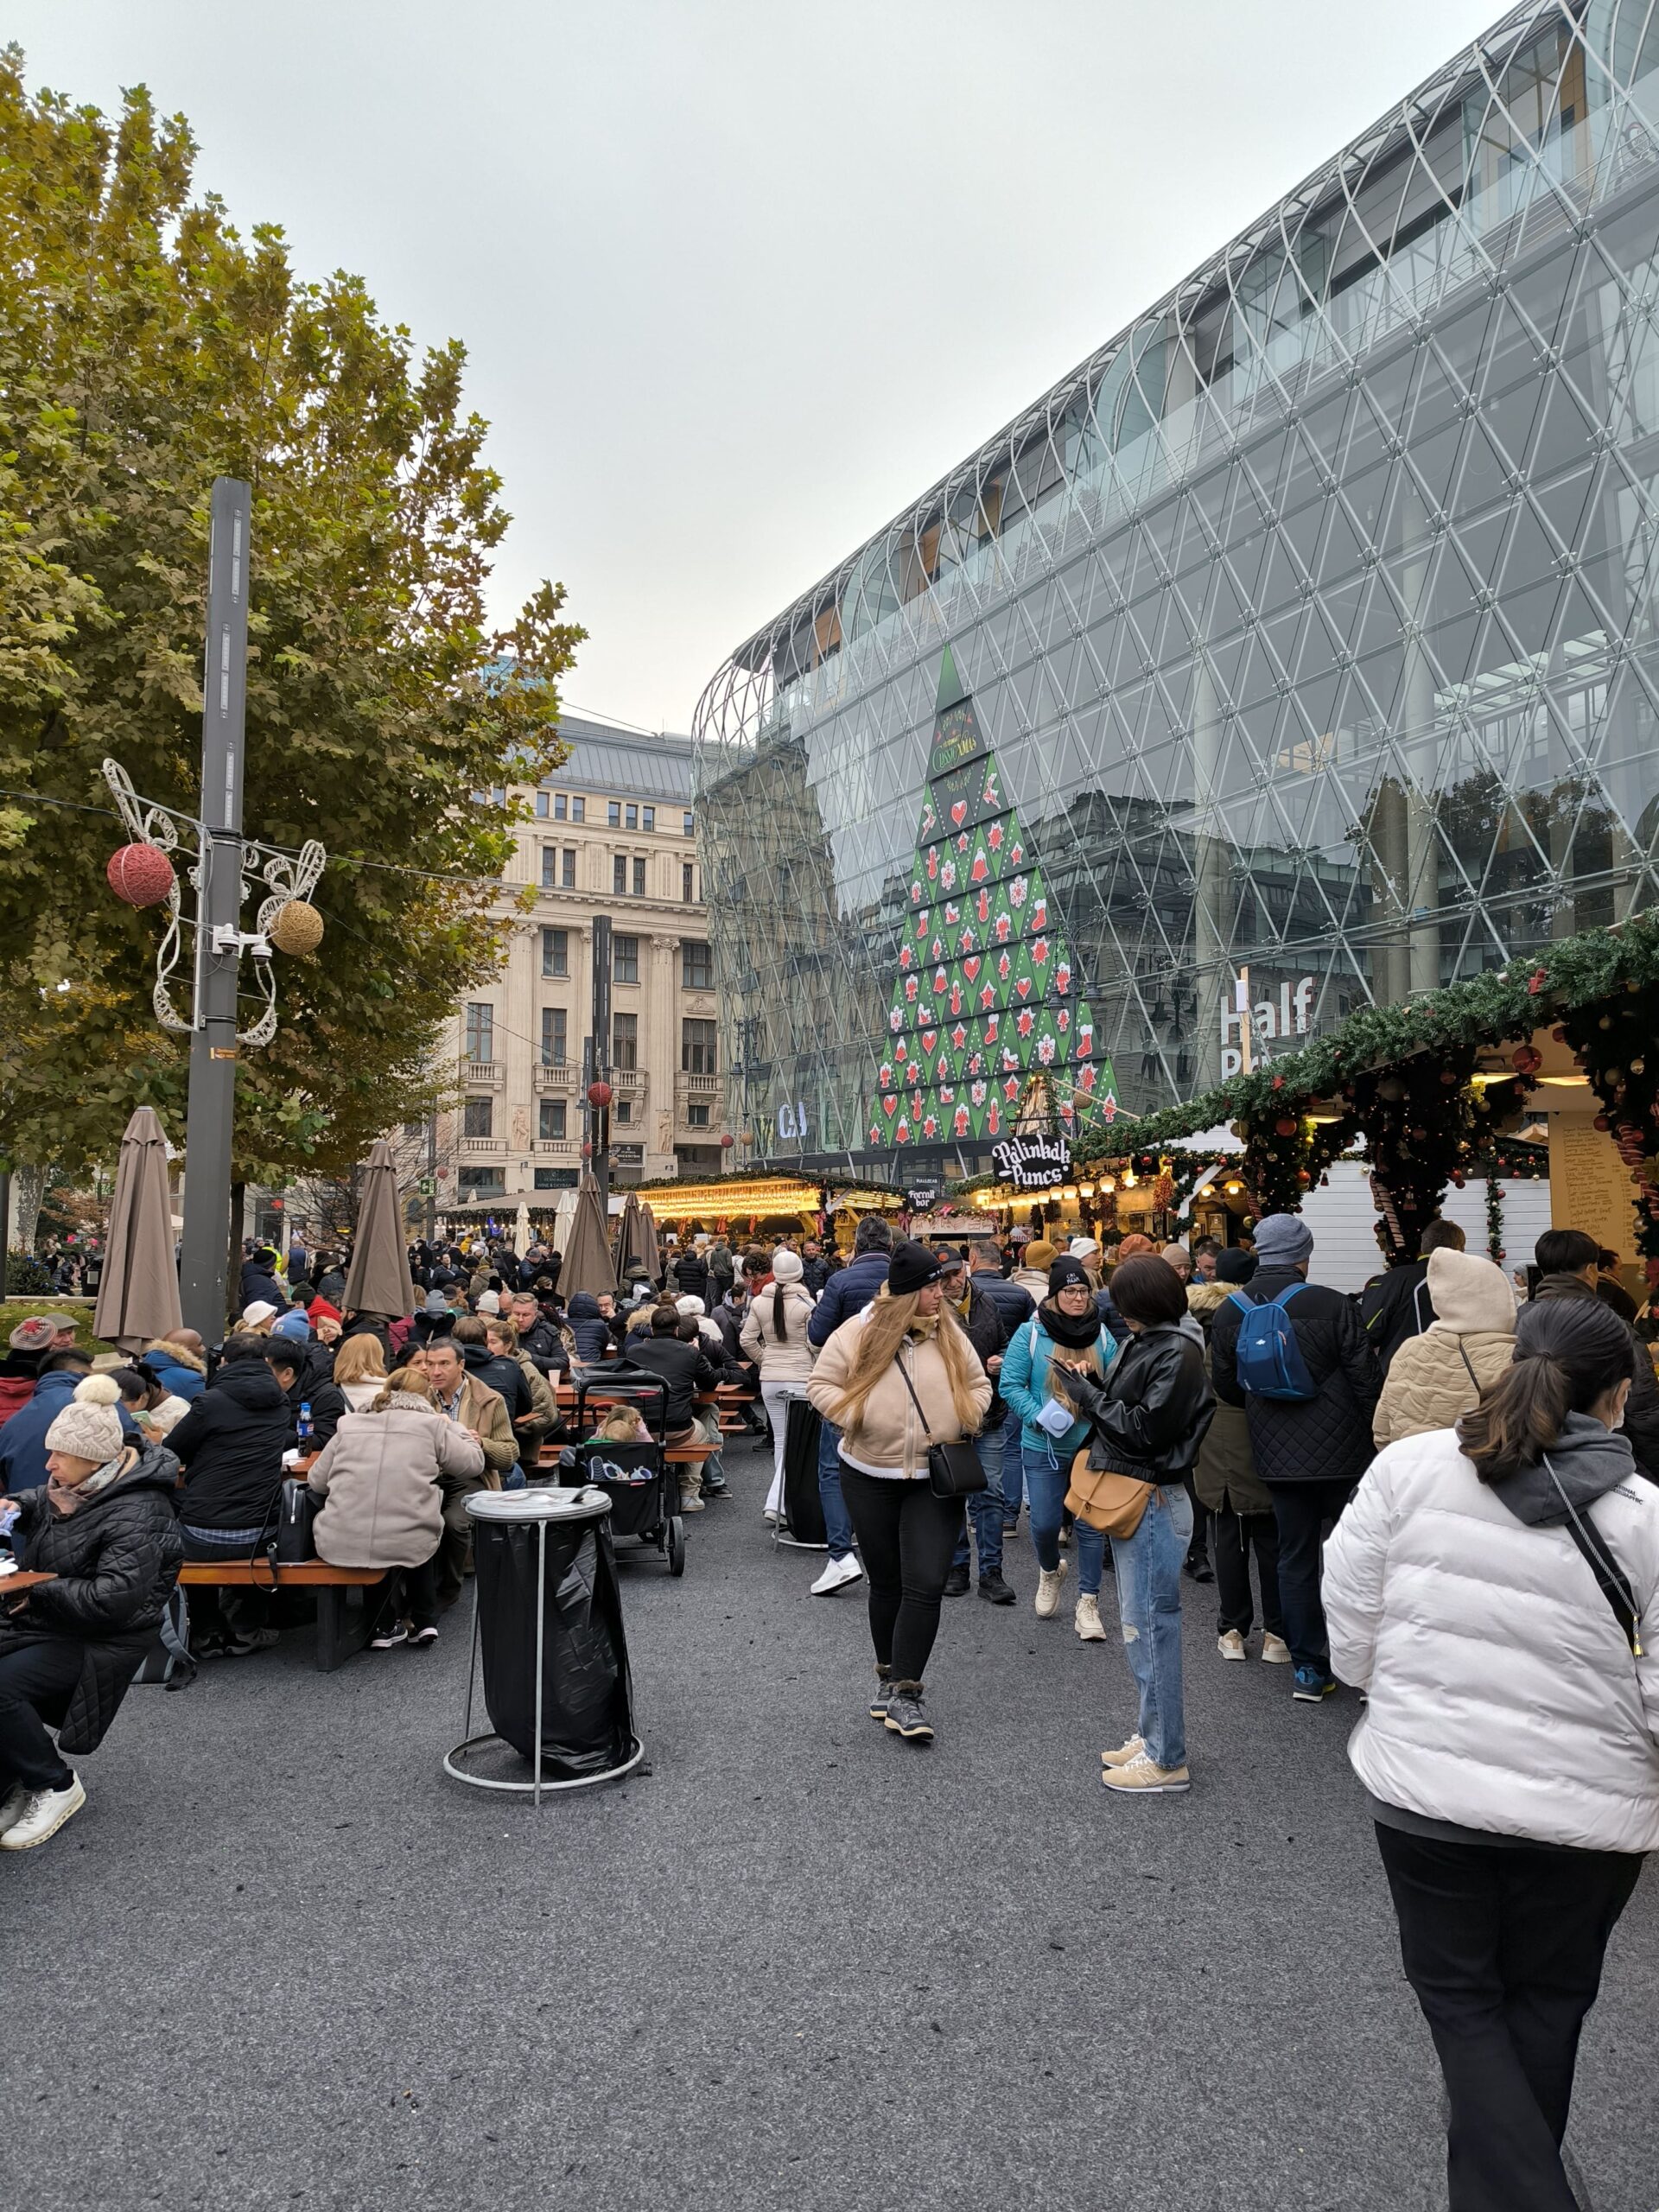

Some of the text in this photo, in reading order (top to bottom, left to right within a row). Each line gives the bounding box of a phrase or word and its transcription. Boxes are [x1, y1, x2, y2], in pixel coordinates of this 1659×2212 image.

[1221, 977, 1313, 1046] Half
[1012, 1163, 1063, 1185] Puncs
[916, 1198, 930, 1207] bor
